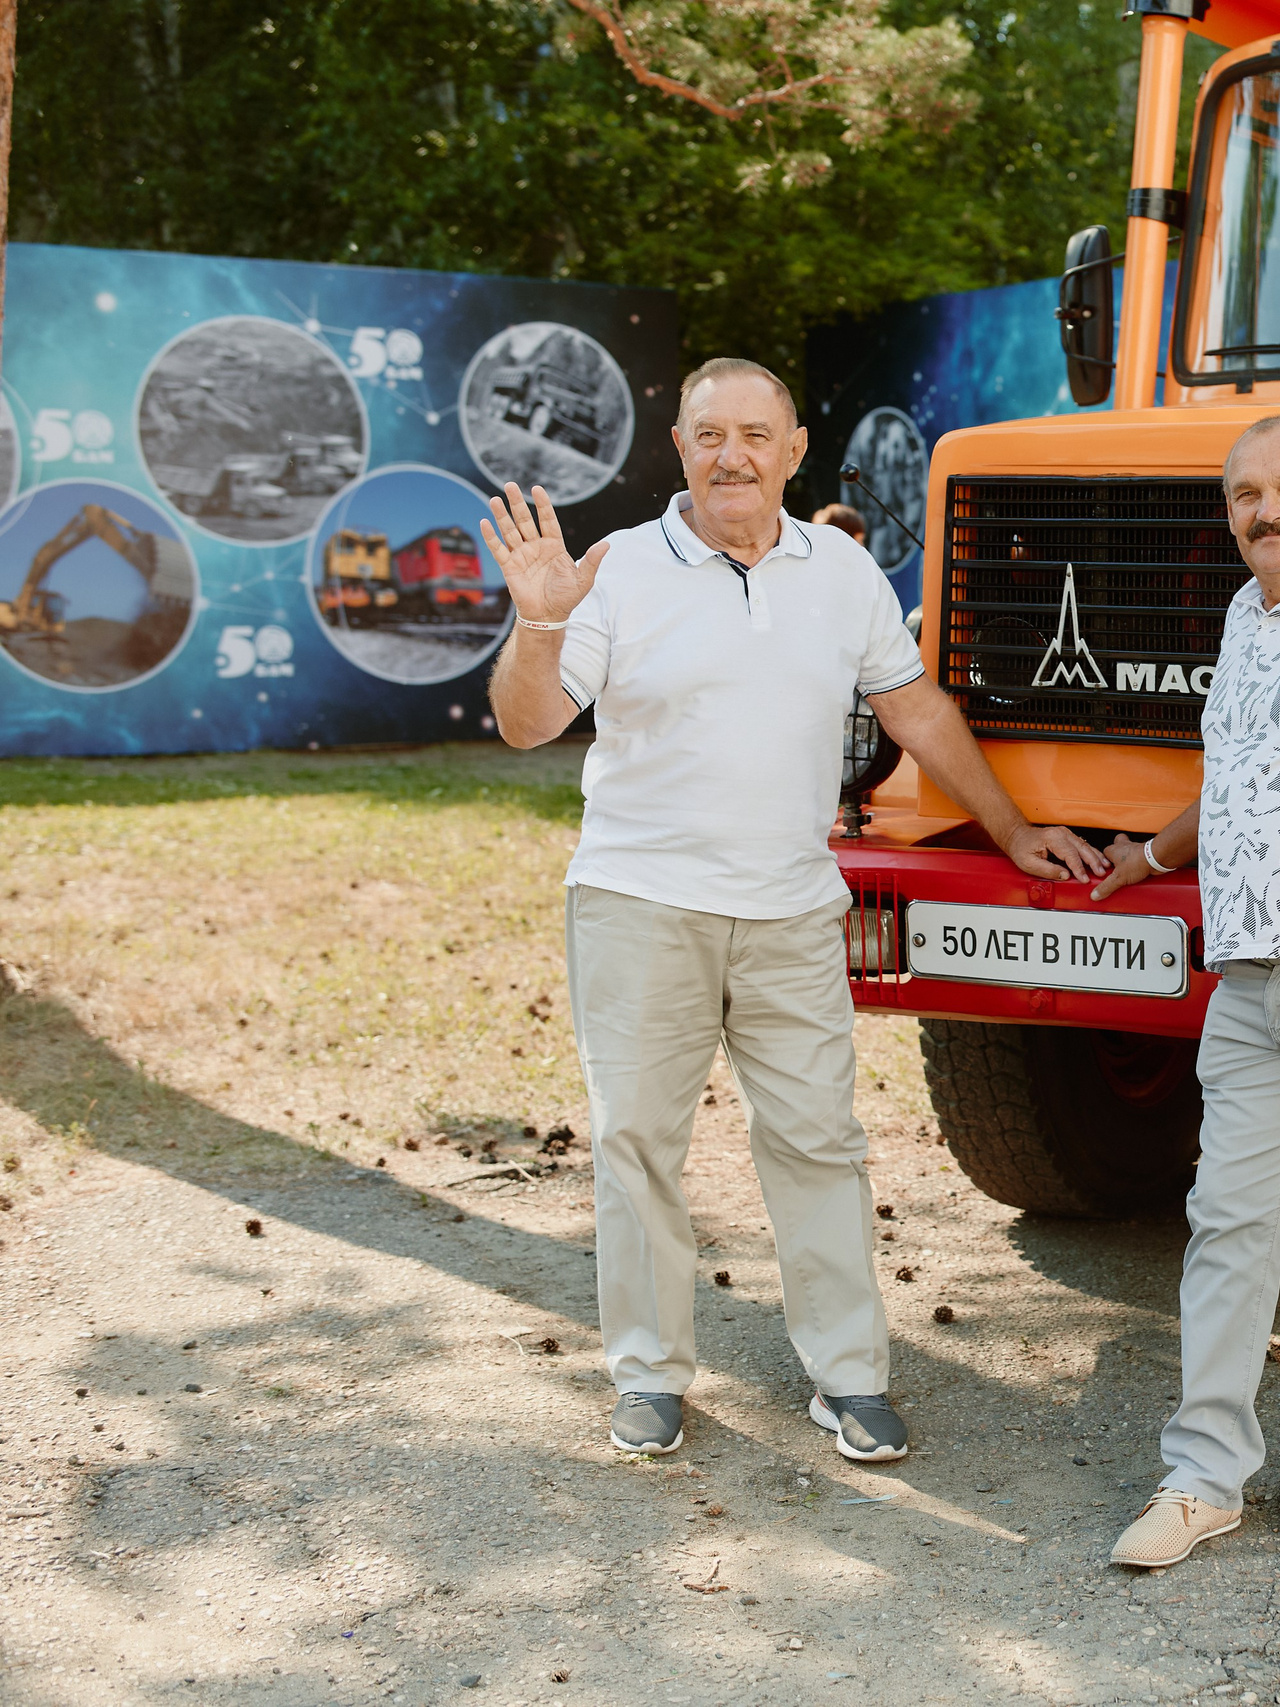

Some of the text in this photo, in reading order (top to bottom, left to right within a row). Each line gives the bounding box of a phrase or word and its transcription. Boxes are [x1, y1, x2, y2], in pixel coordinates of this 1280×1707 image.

[942, 925, 1146, 971] 50 ЛЕТ В ПУТИ
